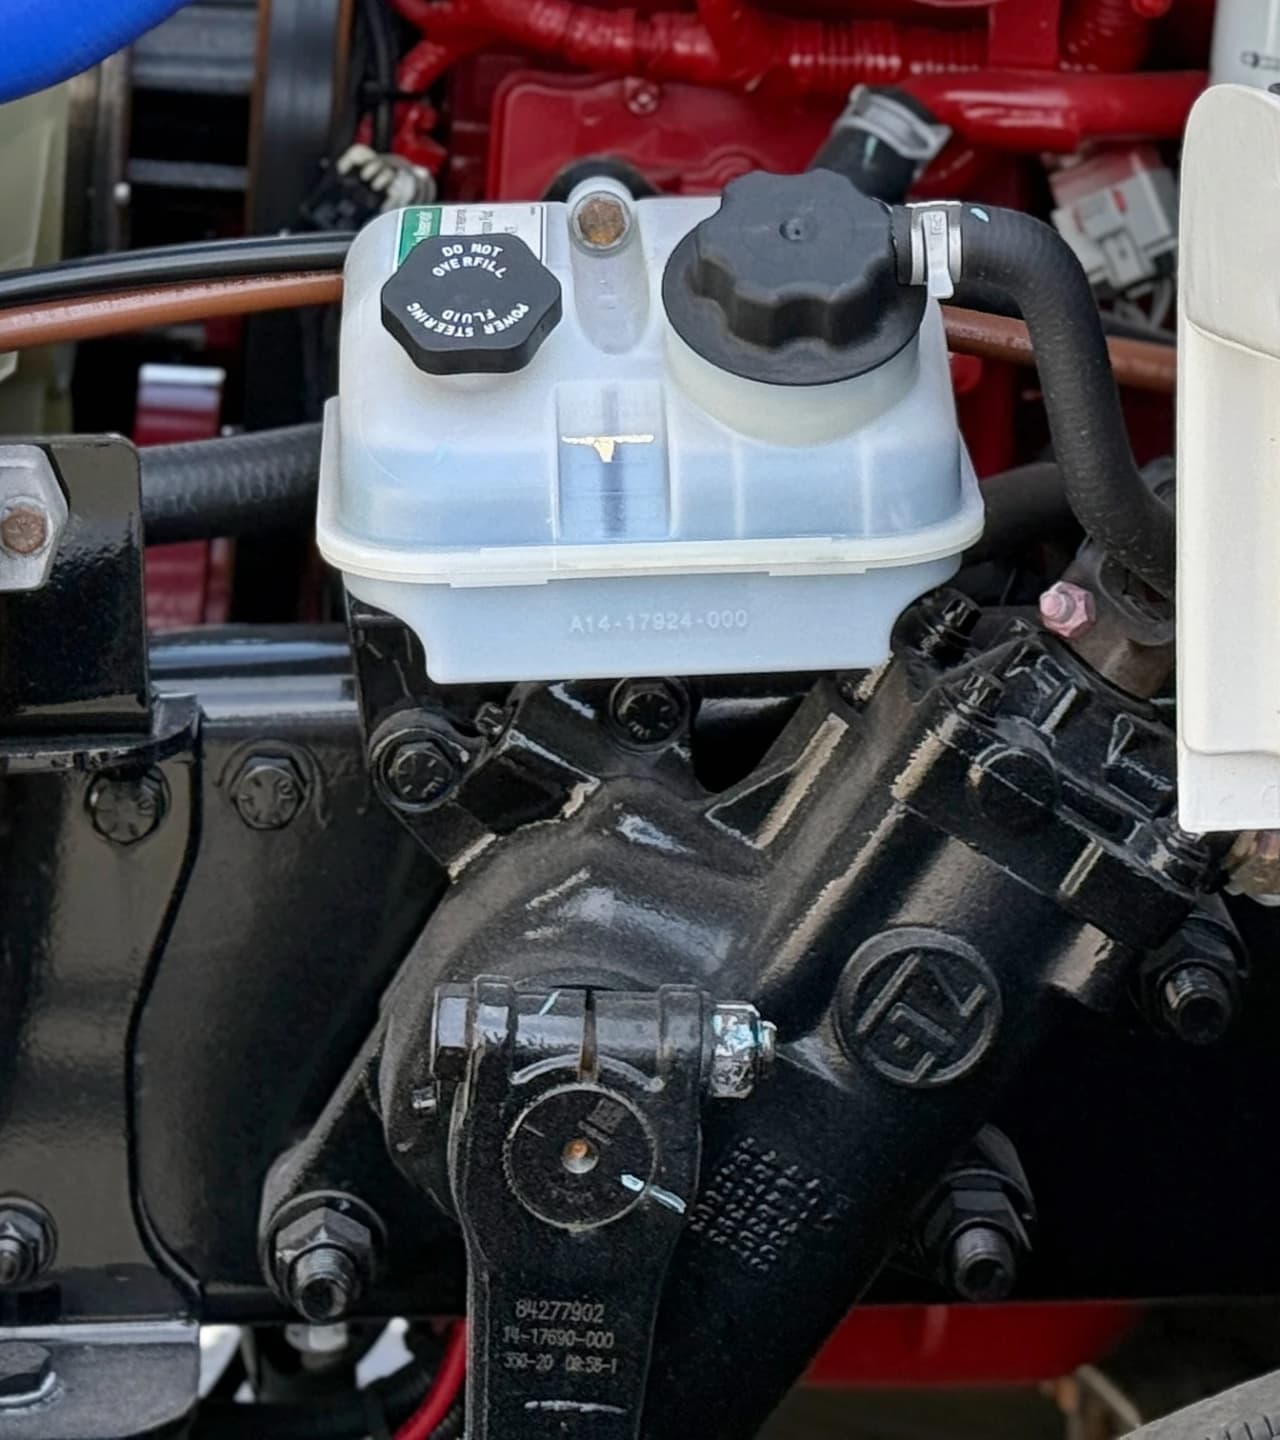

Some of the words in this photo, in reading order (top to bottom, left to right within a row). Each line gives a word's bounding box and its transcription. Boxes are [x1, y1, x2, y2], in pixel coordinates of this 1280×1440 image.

[441, 243, 464, 258] DO
[470, 242, 504, 258] NOT
[431, 256, 508, 279] OVERFILL
[405, 301, 475, 338] STEERING
[441, 308, 497, 324] FLUID
[482, 302, 531, 336] POWER
[569, 608, 748, 634] A14-17924-000
